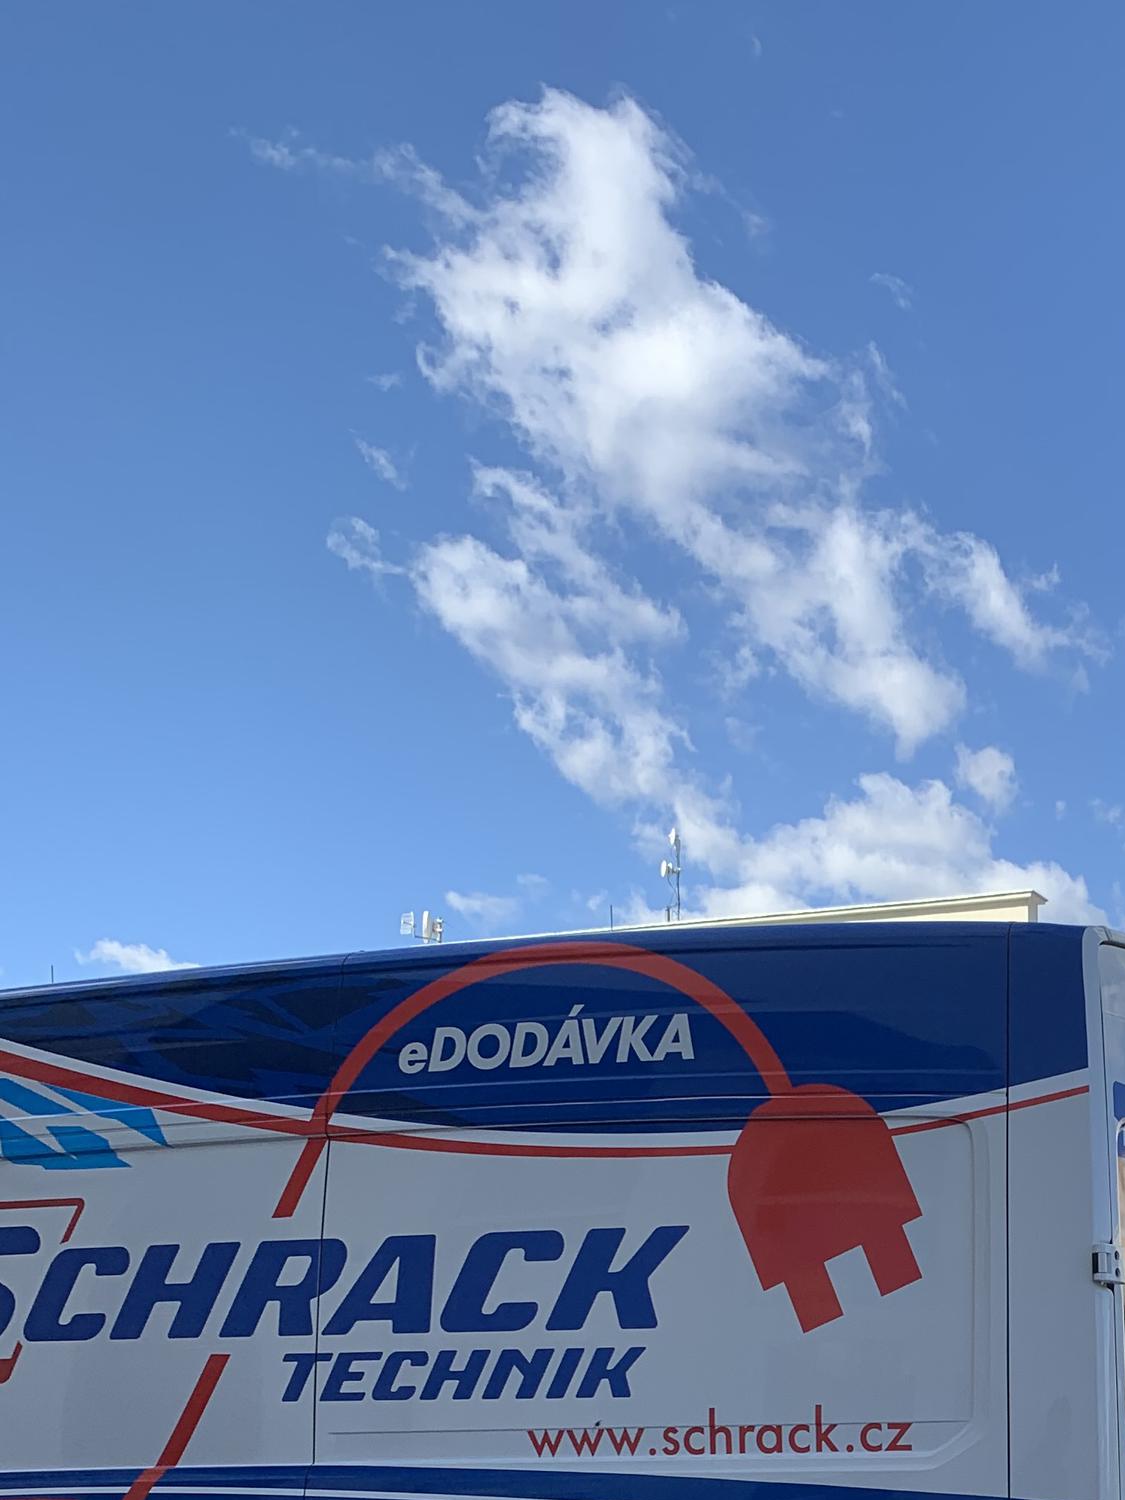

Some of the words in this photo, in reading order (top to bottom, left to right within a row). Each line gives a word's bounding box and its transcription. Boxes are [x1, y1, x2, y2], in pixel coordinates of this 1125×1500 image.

[398, 1003, 695, 1075] eDODÁVKA
[281, 1346, 647, 1402] TECHNIK
[526, 1403, 914, 1459] www.schrack.cz
